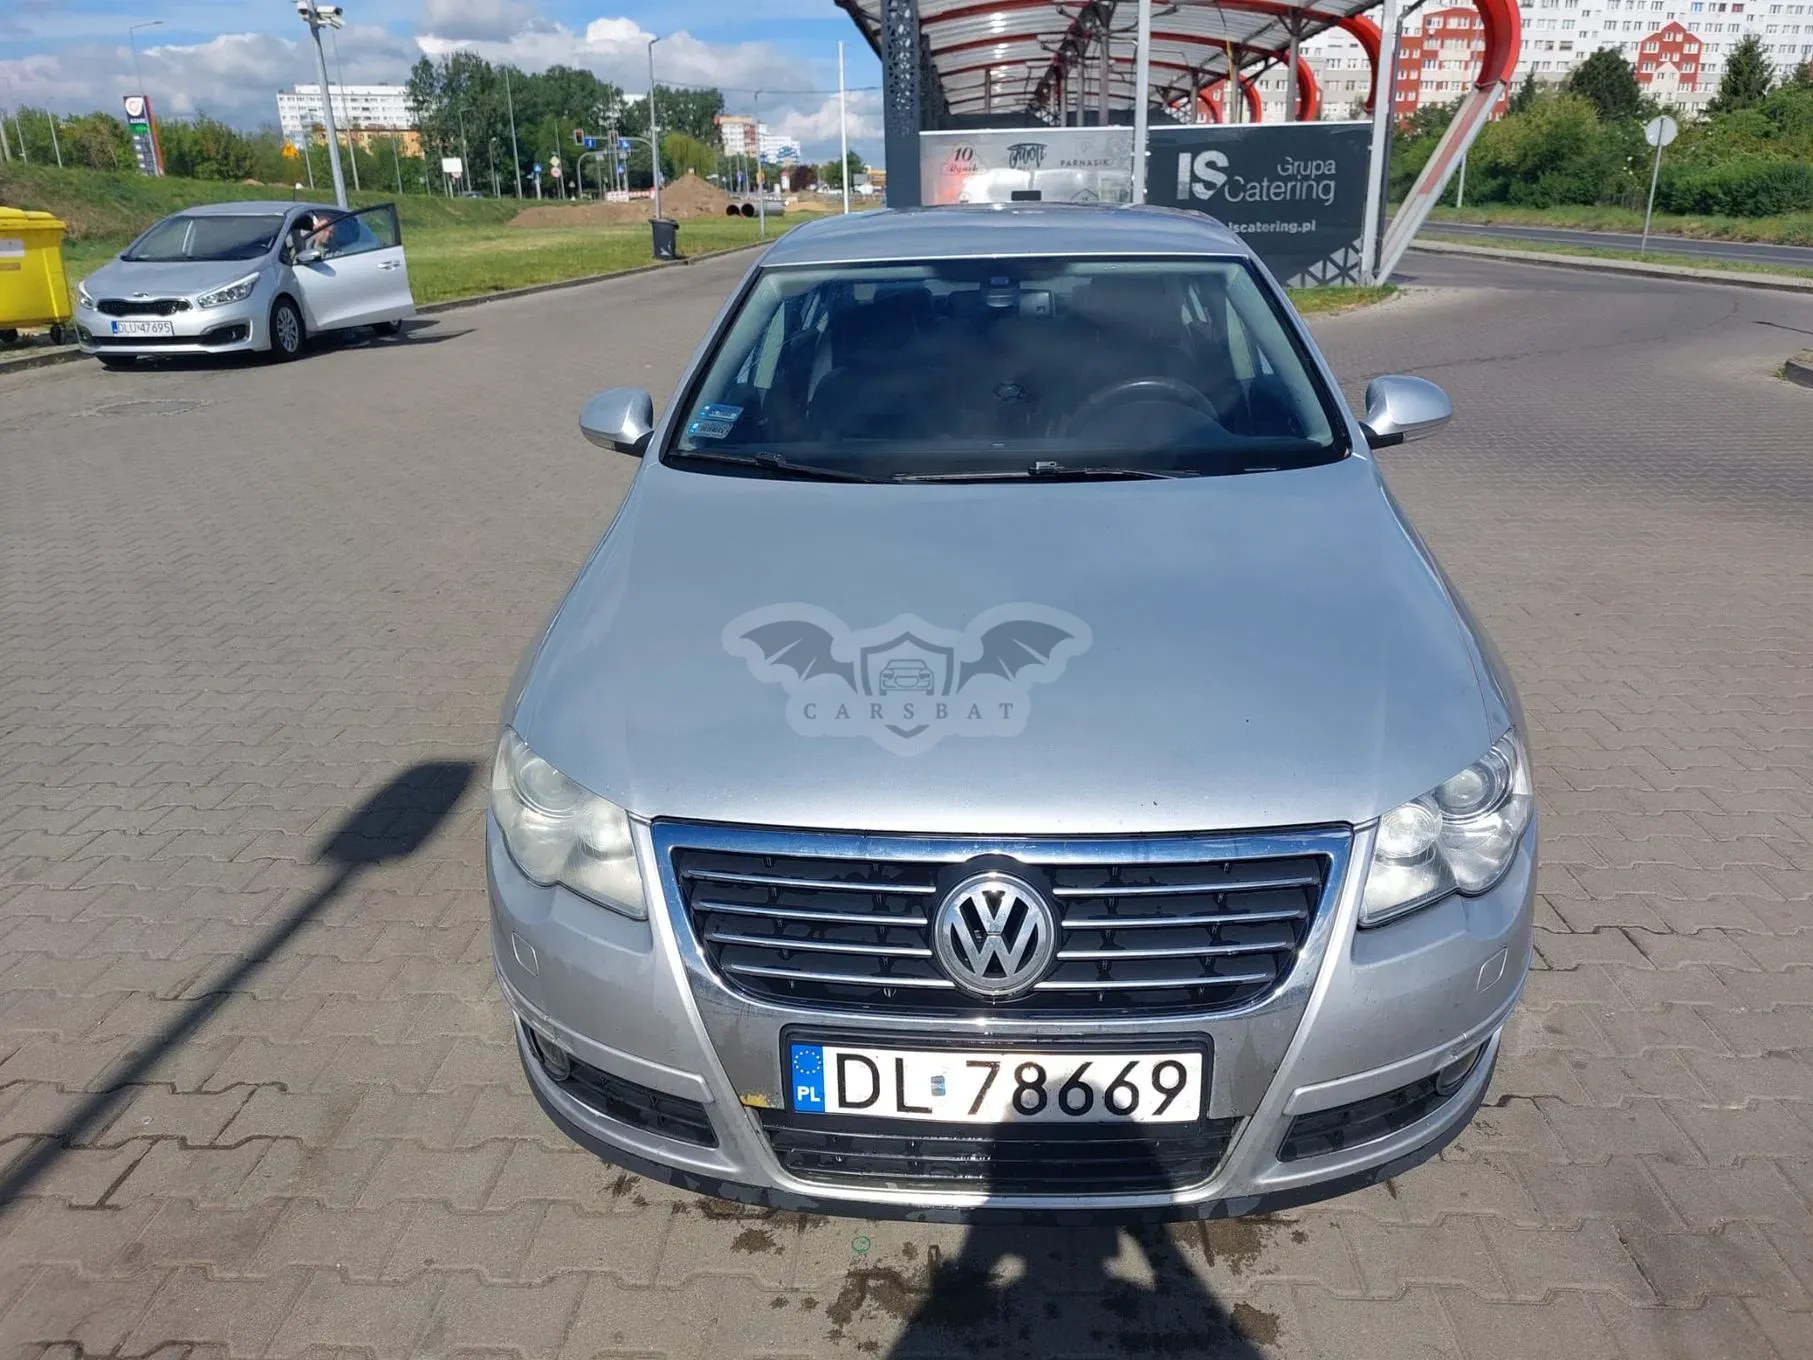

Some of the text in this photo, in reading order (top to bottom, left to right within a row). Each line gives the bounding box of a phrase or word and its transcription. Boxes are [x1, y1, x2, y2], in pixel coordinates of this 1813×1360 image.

[955, 147, 973, 161] 10
[1177, 150, 1229, 200] IS
[1277, 157, 1336, 178] Grupa
[1224, 175, 1336, 206] Catering
[797, 1086, 821, 1102] PL
[836, 1053, 1187, 1116] DL 78669
